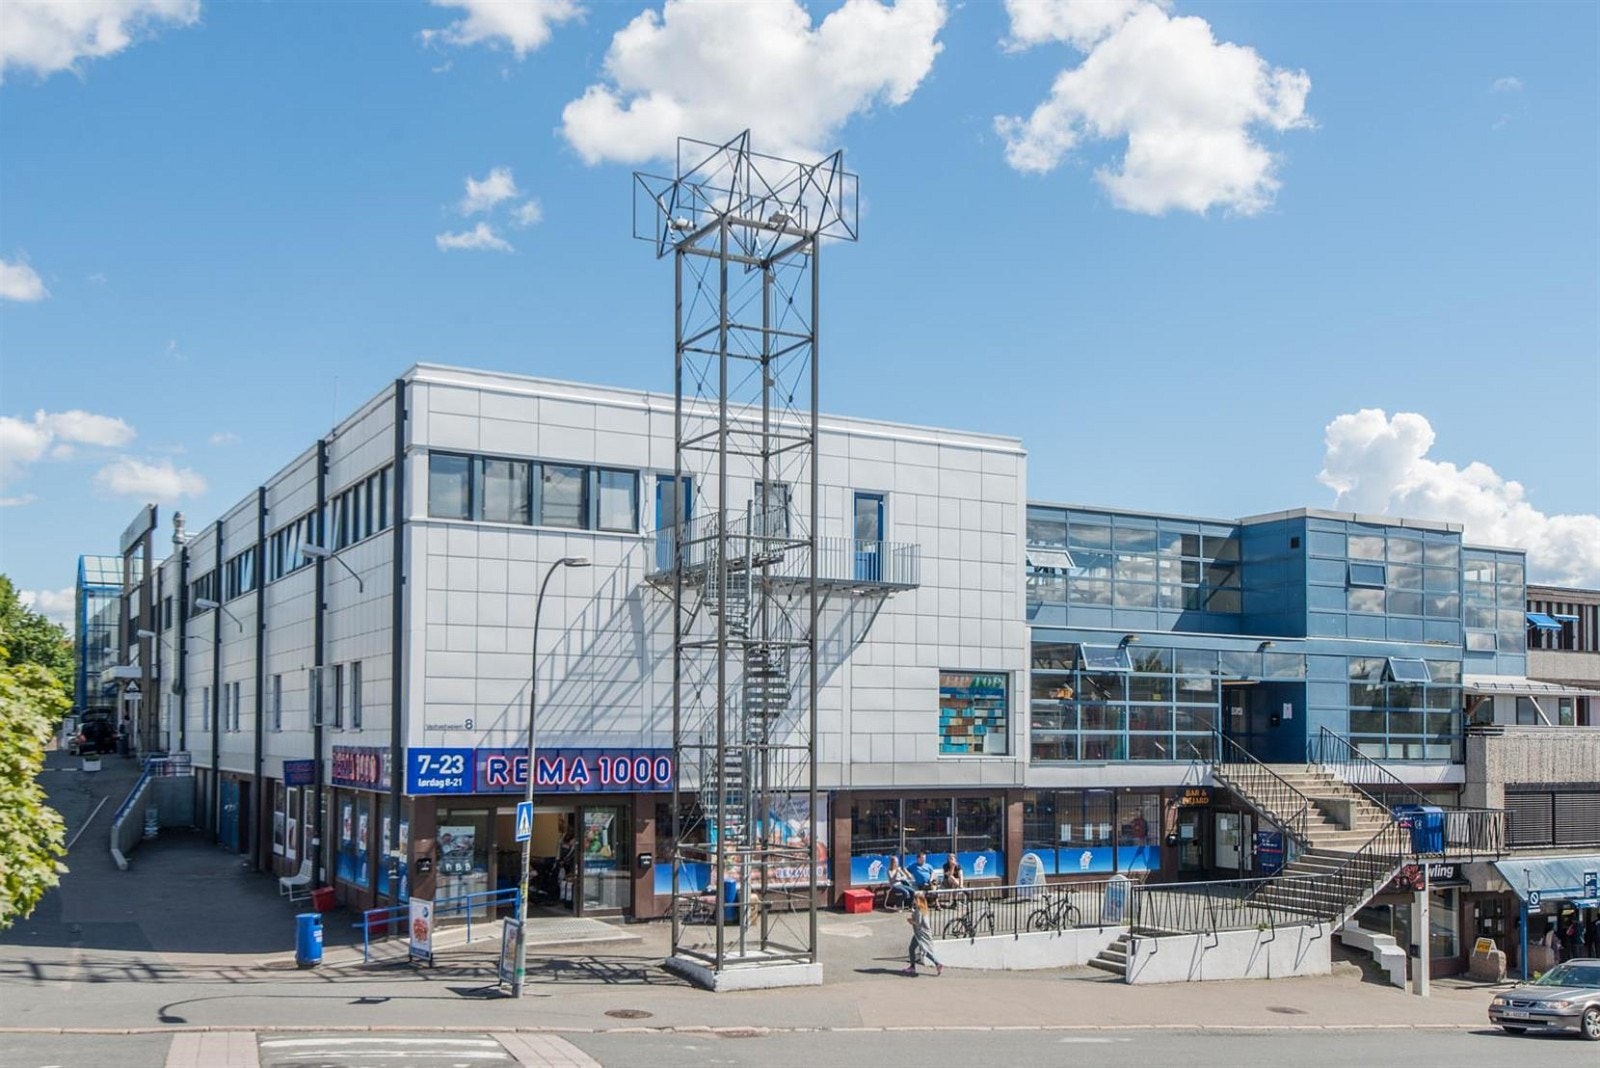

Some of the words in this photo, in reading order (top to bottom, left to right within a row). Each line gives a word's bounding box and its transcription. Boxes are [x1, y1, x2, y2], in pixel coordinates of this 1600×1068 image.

[465, 718, 473, 730] 8
[418, 755, 464, 774] 7-23
[487, 756, 589, 785] REMA
[599, 755, 671, 784] 1000
[445, 778, 463, 787] 8-21
[1185, 789, 1200, 797] BAR
[1201, 789, 1207, 797] &
